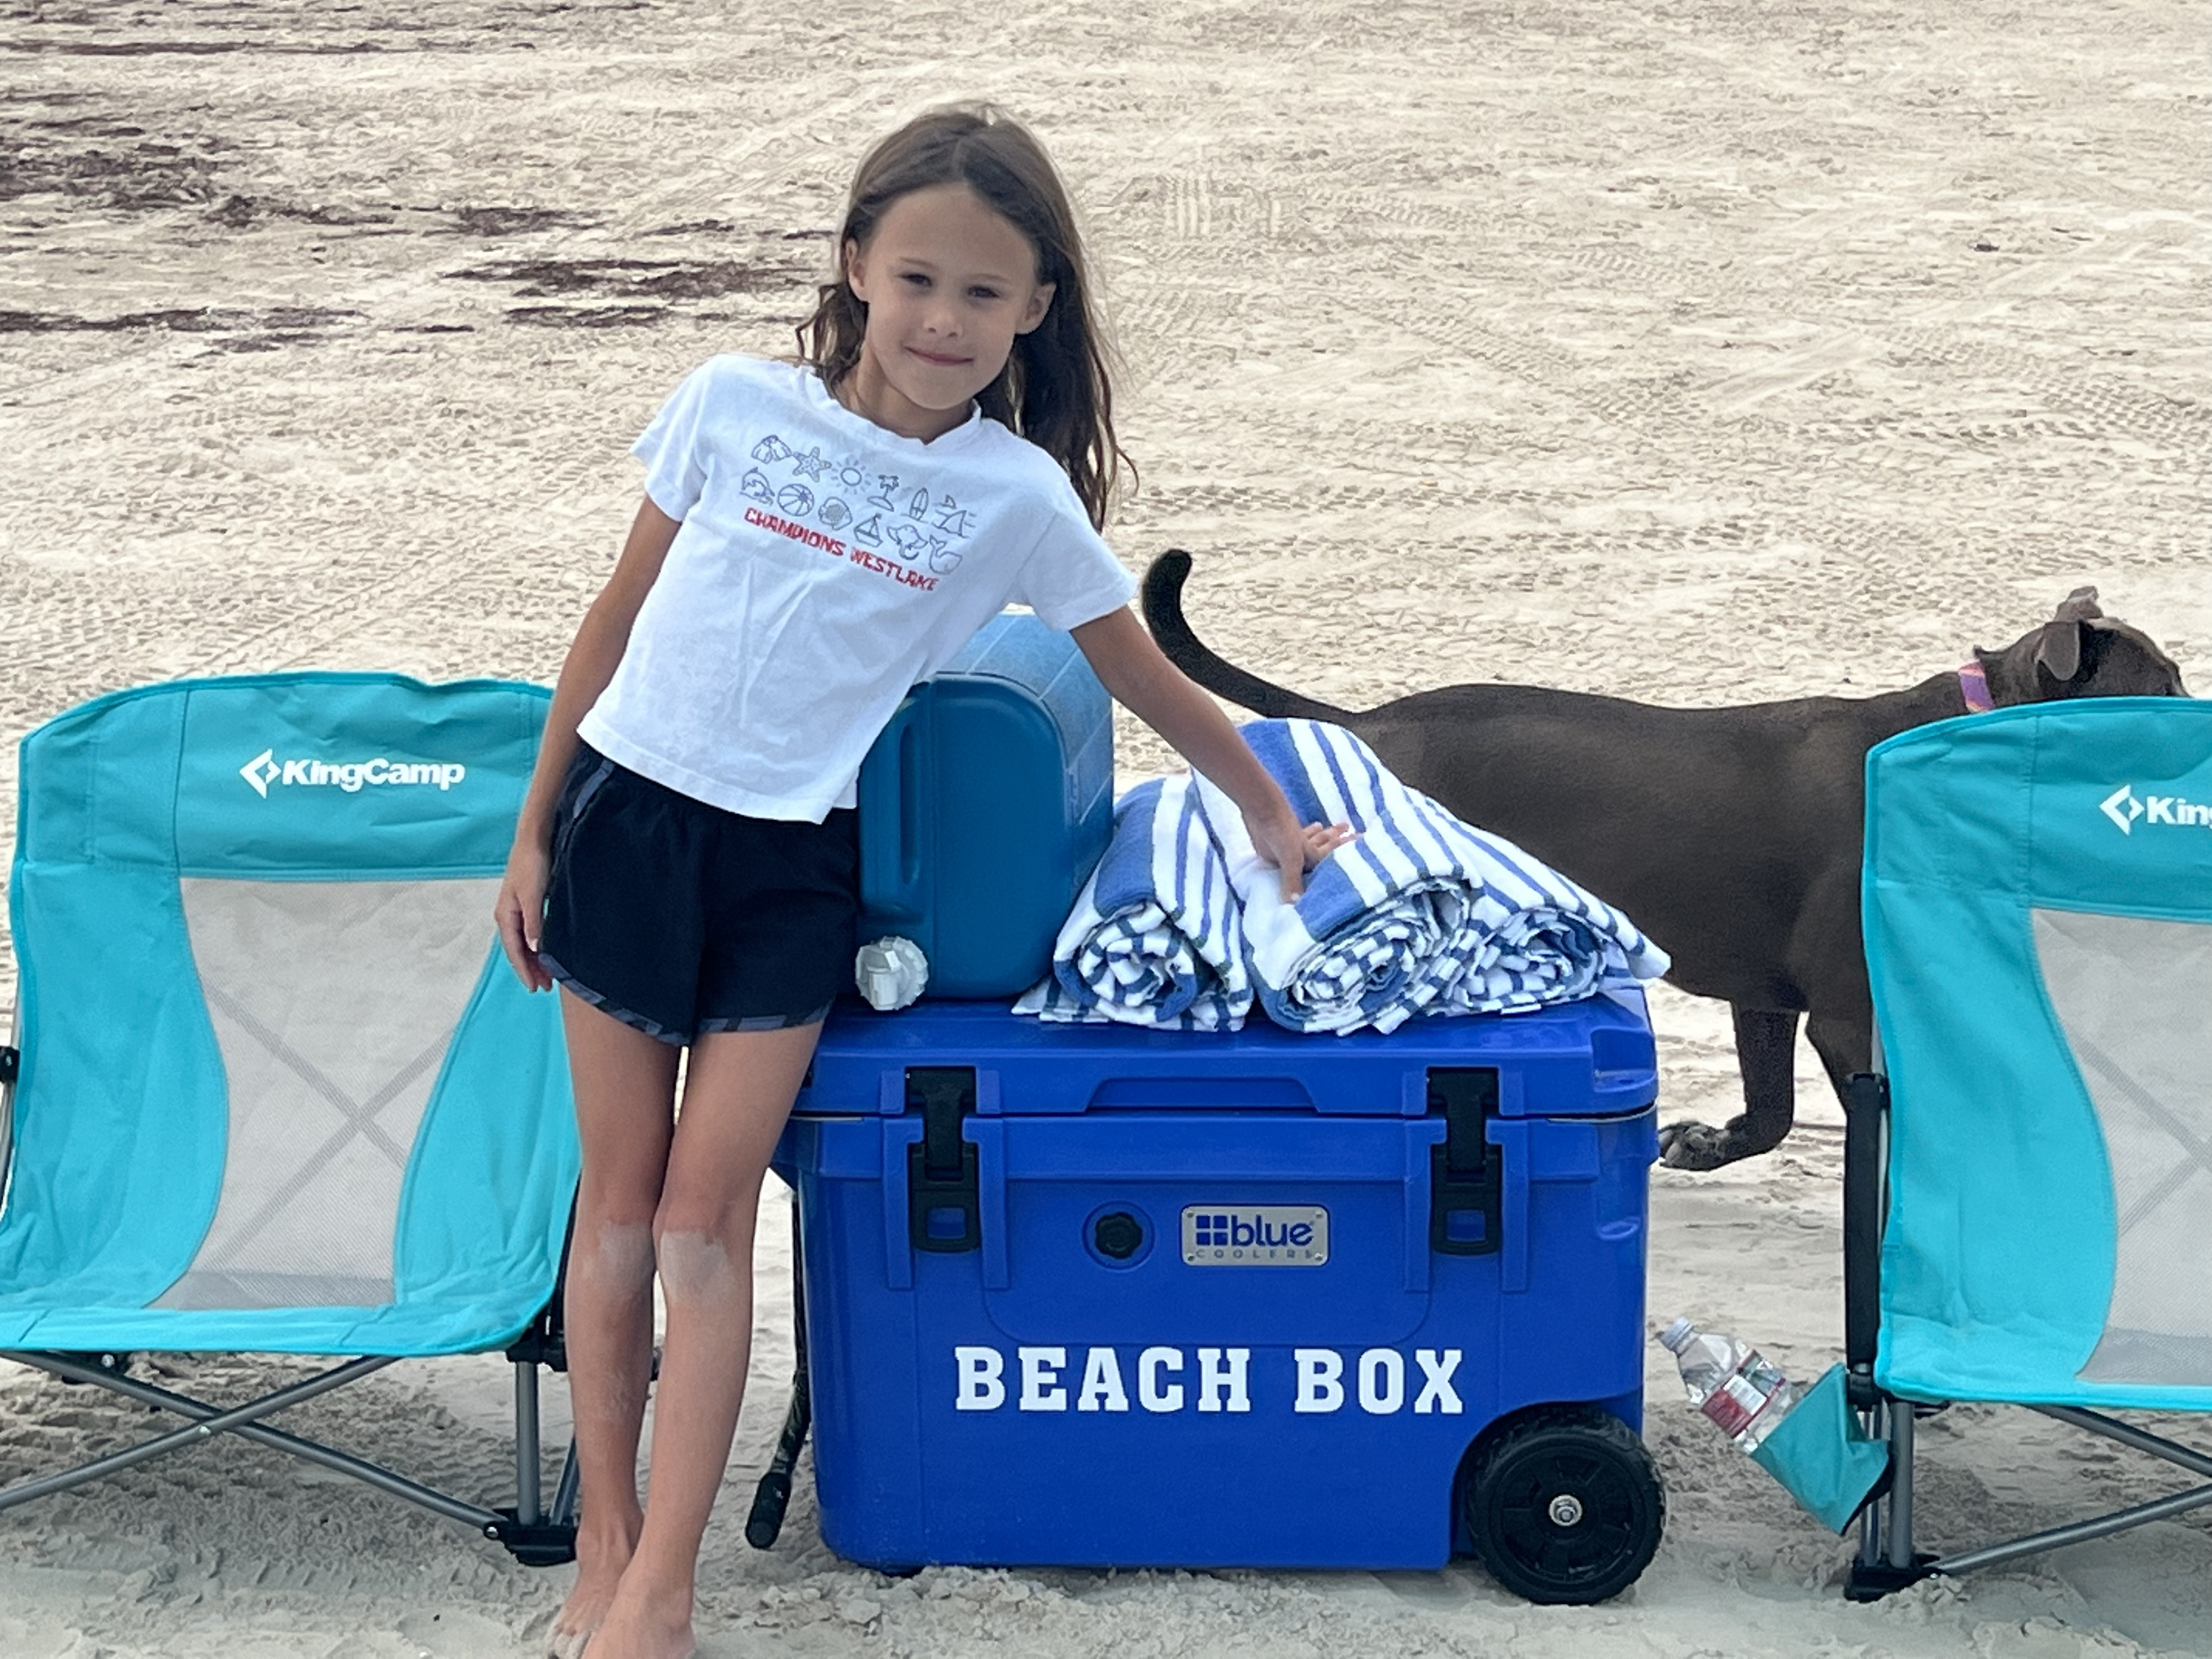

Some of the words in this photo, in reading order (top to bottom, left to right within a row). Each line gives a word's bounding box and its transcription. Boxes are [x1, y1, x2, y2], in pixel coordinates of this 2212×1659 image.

[744, 507, 847, 556] CHAMPIONS
[850, 548, 939, 591] WESTLAKE
[282, 758, 466, 792] KingCamp
[2147, 795, 2212, 830] Kin
[1231, 1214, 1314, 1247] blue
[1196, 1249, 1313, 1259] COOLERS
[955, 1346, 1251, 1413] BEACH
[1294, 1348, 1463, 1414] BOX
